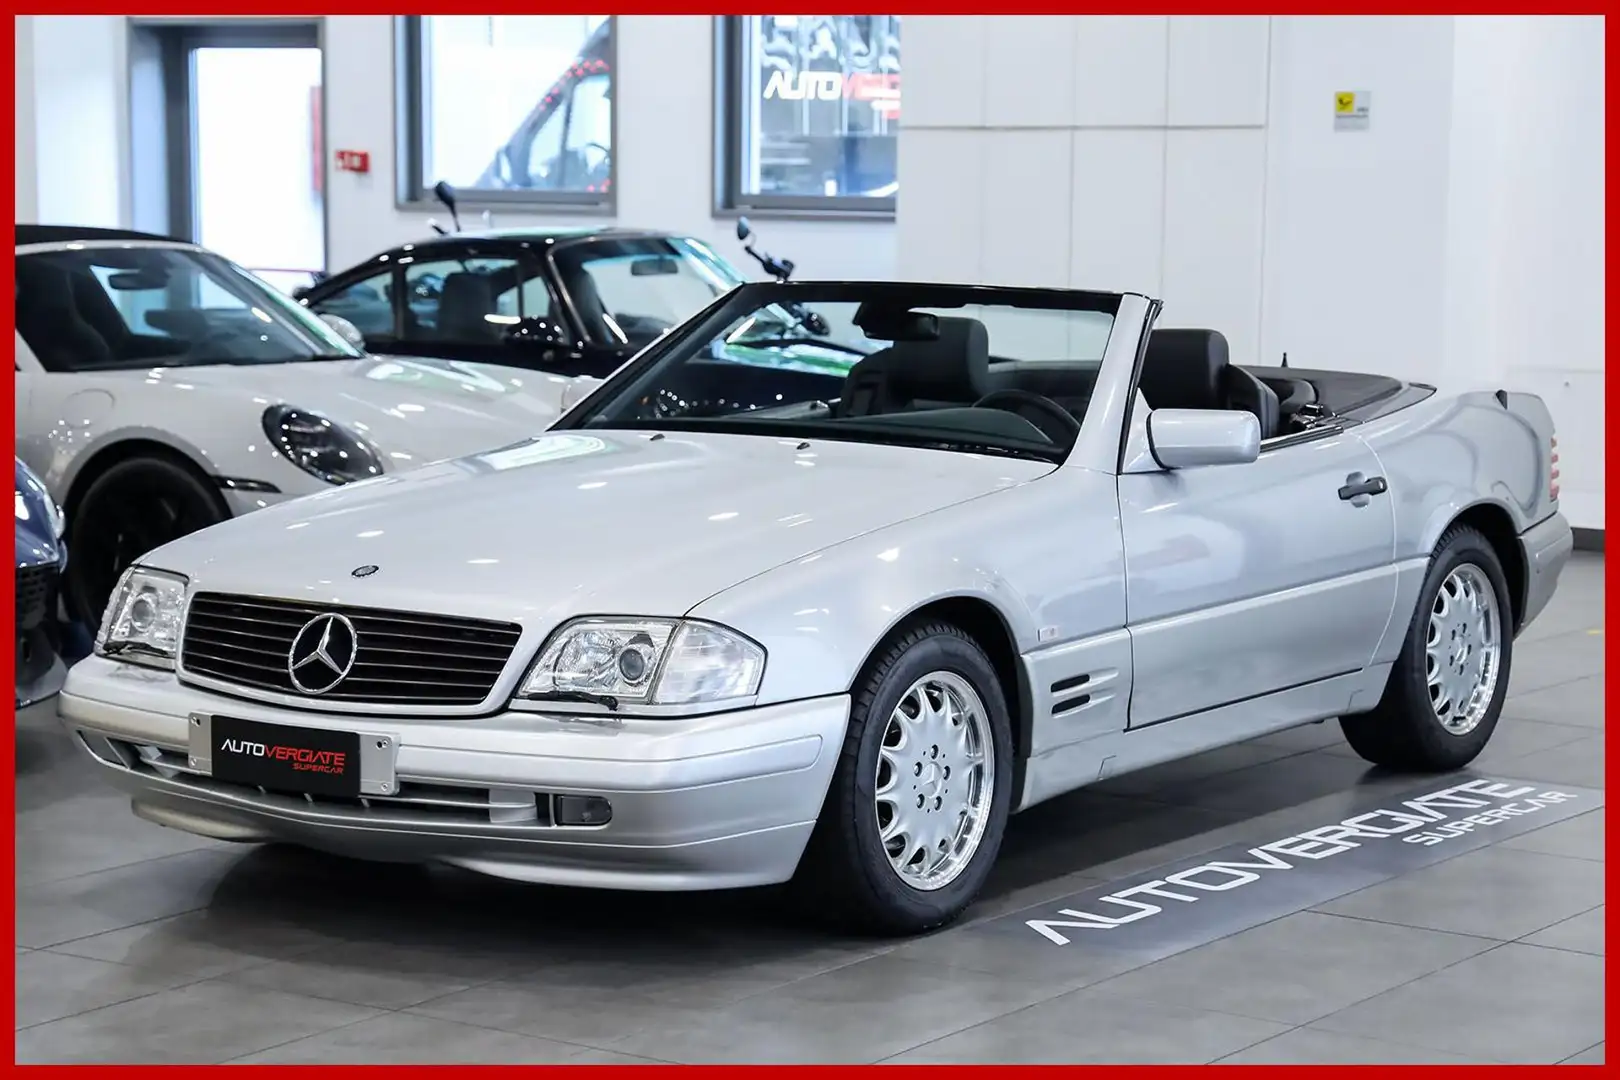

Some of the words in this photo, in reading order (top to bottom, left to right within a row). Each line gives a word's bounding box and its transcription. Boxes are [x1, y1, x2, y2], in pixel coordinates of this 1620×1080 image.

[221, 739, 346, 766] AUTOVERGIATE
[292, 762, 344, 774] SUPERCAR
[1402, 791, 1578, 846] SUPERCAR
[1025, 779, 1536, 945] AUTOVERGIATE
